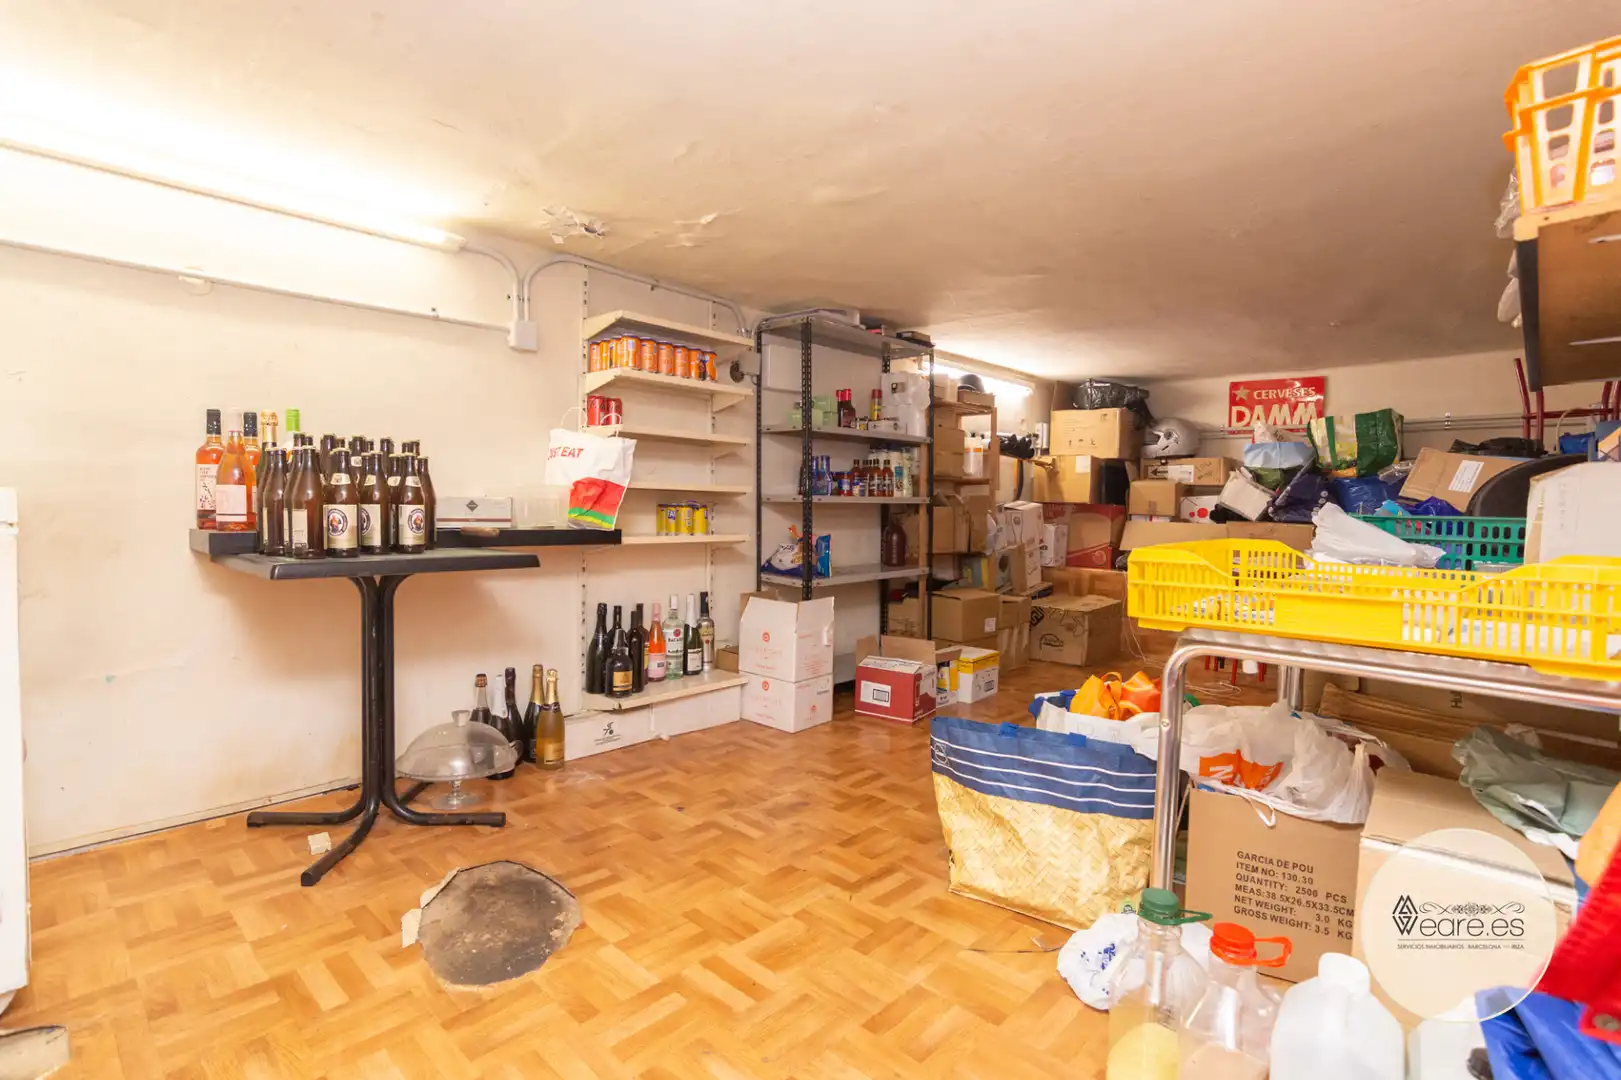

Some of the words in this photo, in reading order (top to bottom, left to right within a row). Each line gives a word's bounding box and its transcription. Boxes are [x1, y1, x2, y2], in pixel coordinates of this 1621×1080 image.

[1253, 386, 1316, 400] CERVESES
[1231, 402, 1318, 427] DAMM
[560, 446, 584, 459] EAT
[1236, 850, 1274, 866] GARCIA
[1276, 859, 1289, 869] DE
[1292, 862, 1314, 874] POU
[1236, 861, 1259, 874] ITEM
[1261, 867, 1279, 878] NO:
[1281, 872, 1314, 885] 130.30
[1235, 872, 1288, 891] QUANTITY:
[1295, 886, 1318, 898] 2500
[1325, 892, 1347, 904] PCS
[1233, 905, 1268, 921] GROSS
[1270, 914, 1312, 931] WEIGHT:
[1314, 925, 1330, 936] 3.5
[1337, 930, 1353, 940] KG
[1234, 894, 1252, 906] NET
[1255, 899, 1297, 916] WEIGHT:
[1315, 913, 1330, 923] 3.0
[1337, 918, 1353, 929] KG
